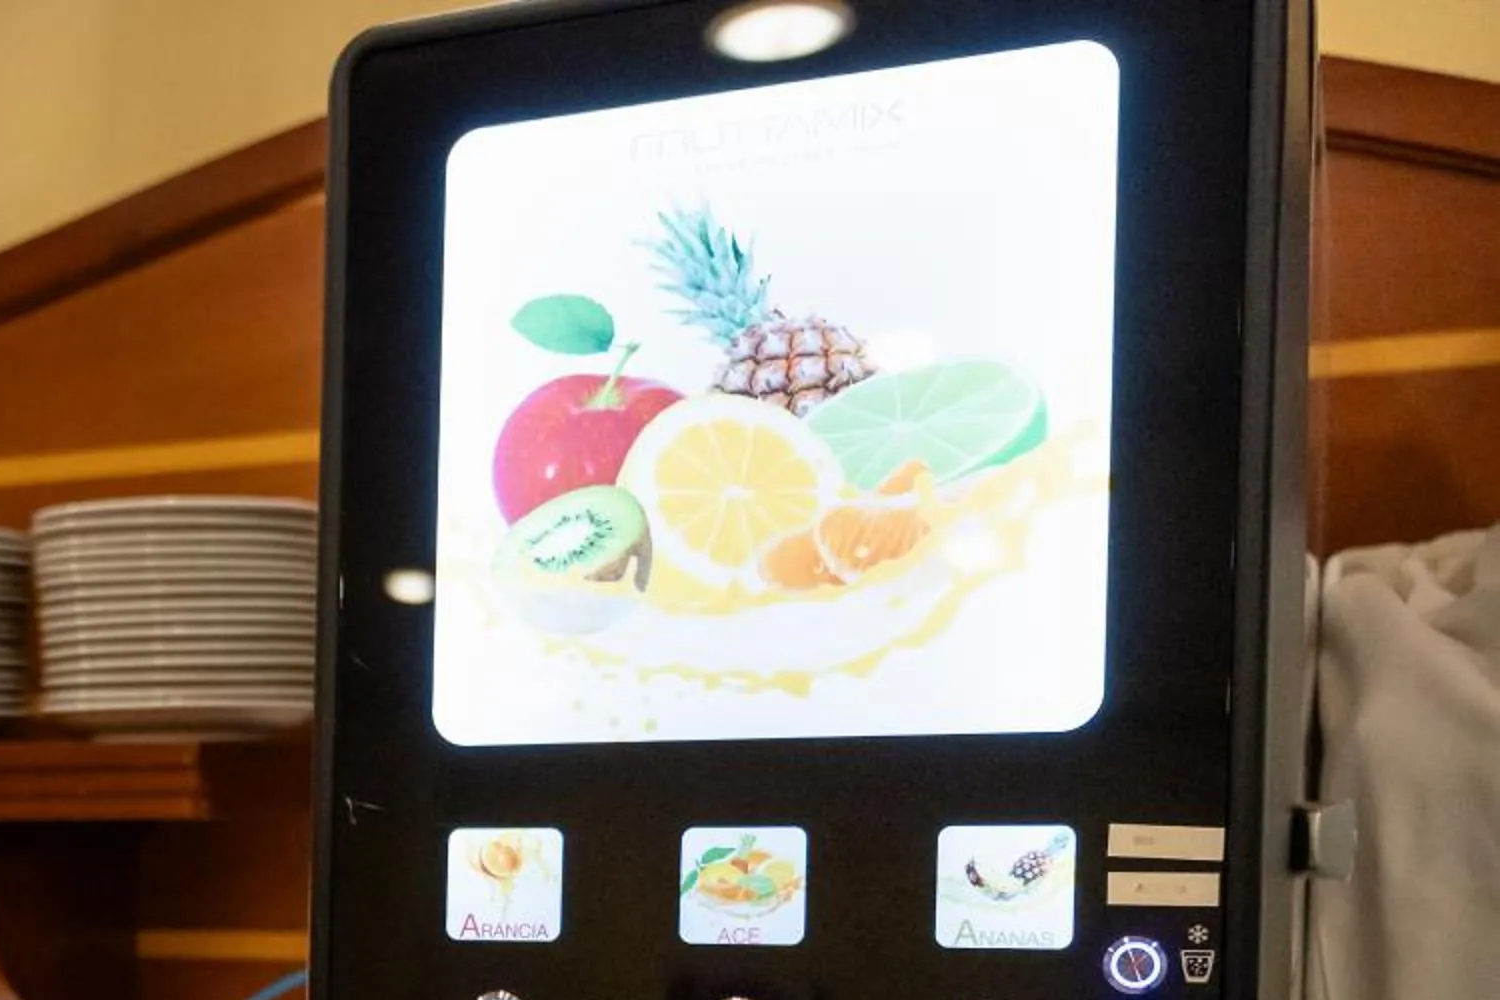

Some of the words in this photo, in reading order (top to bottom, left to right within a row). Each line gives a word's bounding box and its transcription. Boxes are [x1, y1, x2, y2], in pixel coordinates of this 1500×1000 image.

[458, 912, 550, 940] ARANCIA
[716, 926, 763, 945] ACE
[953, 918, 1056, 947] ANANAS
